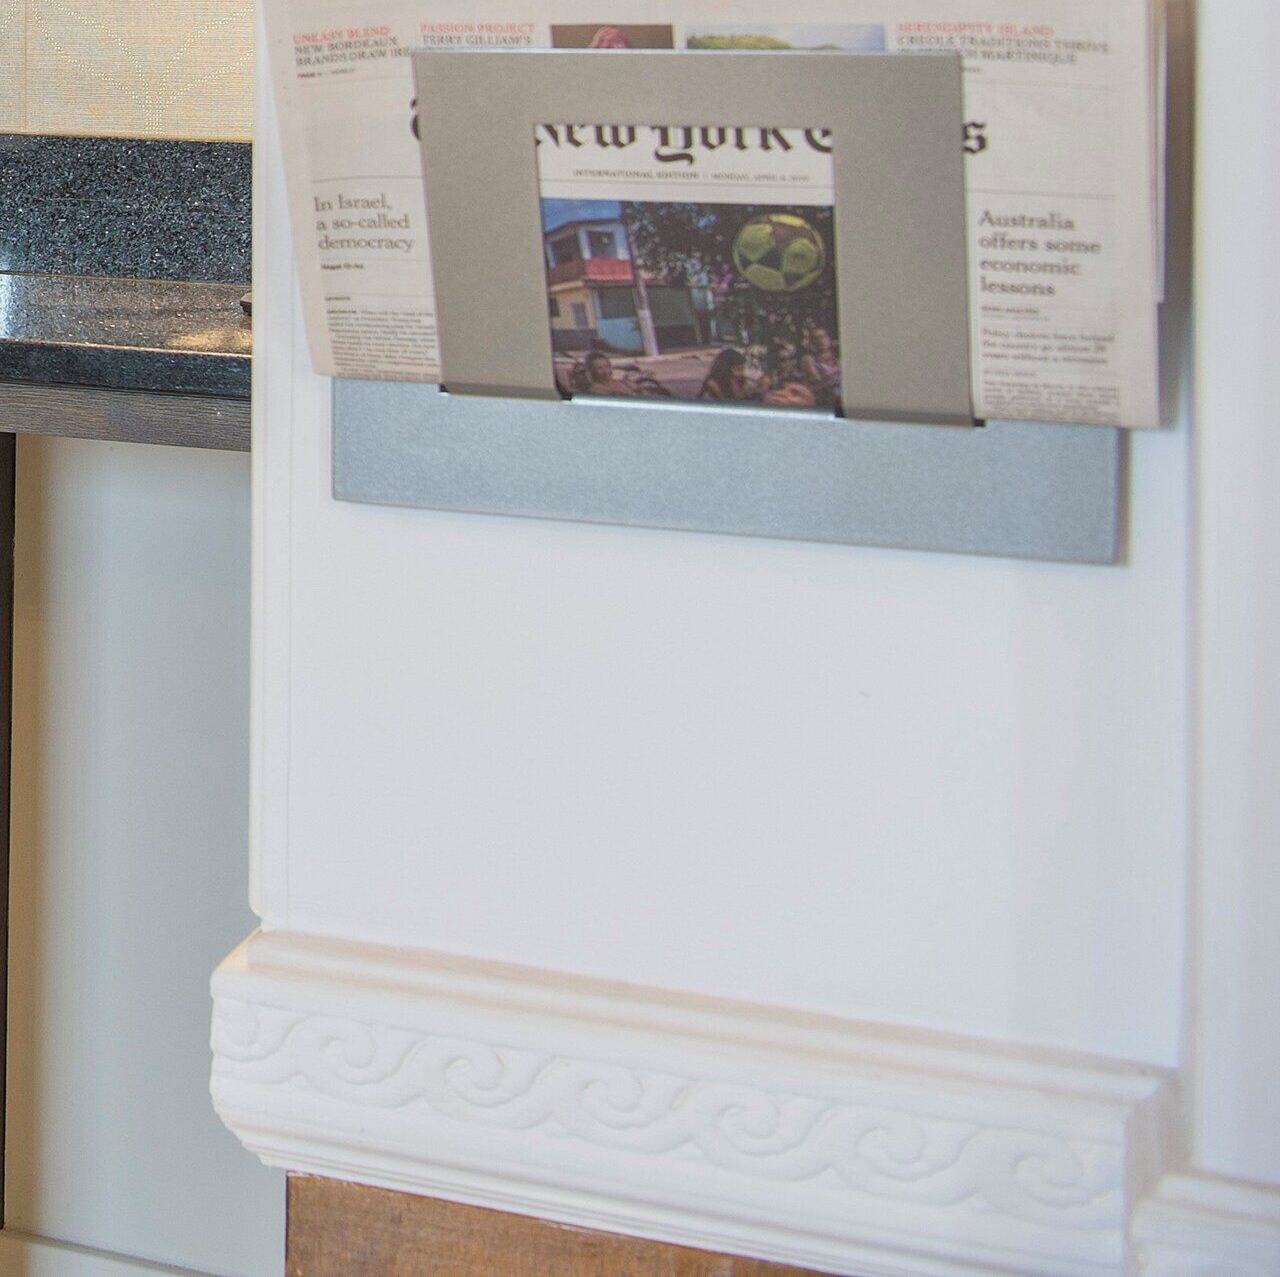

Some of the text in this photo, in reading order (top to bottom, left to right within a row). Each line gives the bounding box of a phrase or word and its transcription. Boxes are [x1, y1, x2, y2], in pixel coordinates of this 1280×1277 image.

[294, 35, 398, 55] NEW BORDEAUX
[314, 192, 393, 212] In Israel,
[315, 212, 411, 231] a so-called
[978, 209, 1076, 232] Australia
[318, 234, 416, 253] democracy
[977, 232, 1102, 256] offers some
[978, 256, 1082, 276] economic
[980, 275, 1056, 297] lessons
